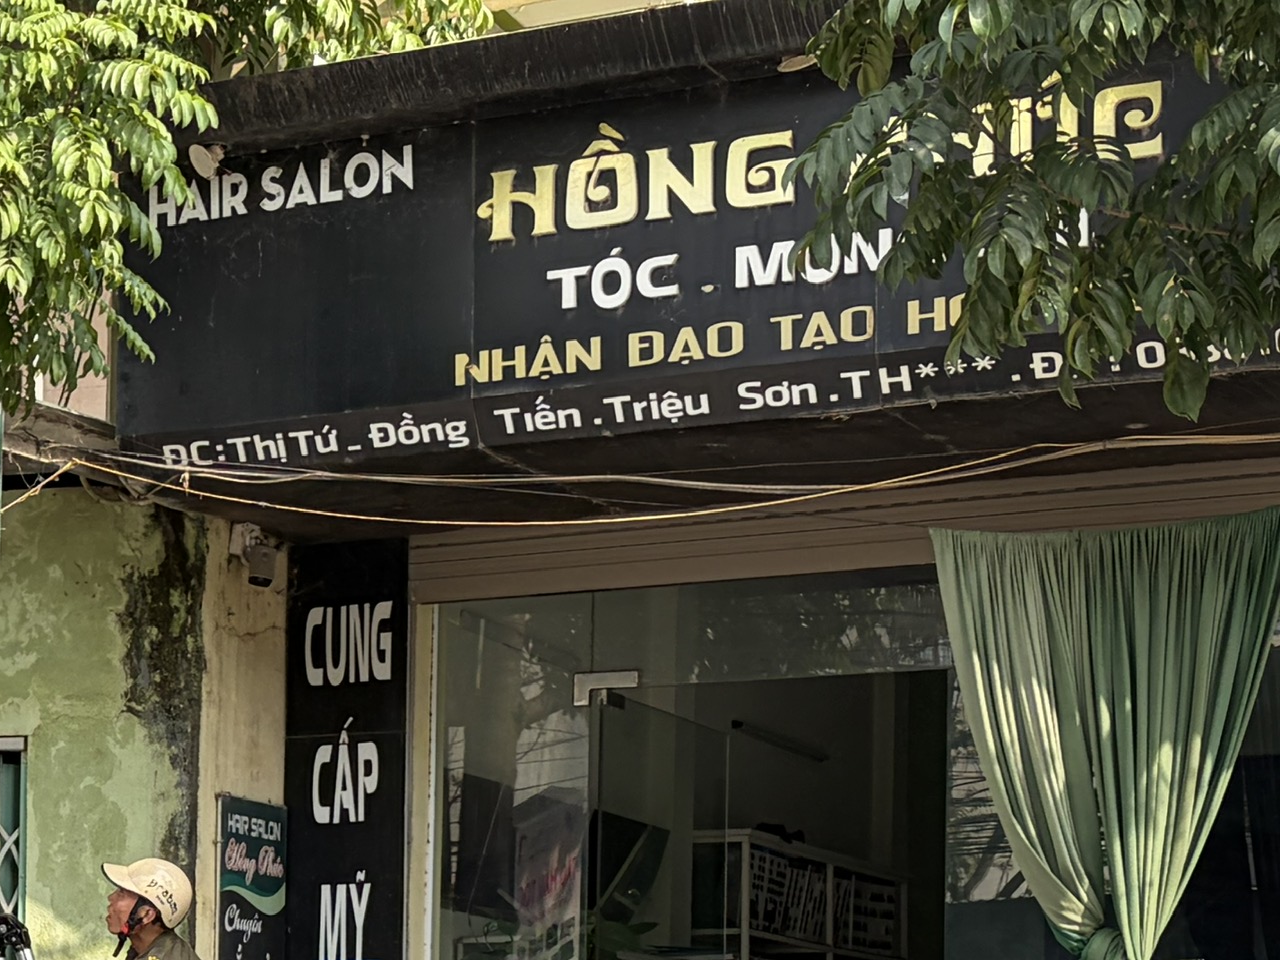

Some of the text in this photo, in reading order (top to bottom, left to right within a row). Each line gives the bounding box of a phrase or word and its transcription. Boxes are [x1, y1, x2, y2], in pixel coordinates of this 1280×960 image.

[149, 144, 413, 228] HAIR SALON
[476, 122, 797, 242] HỒNG
[546, 247, 680, 310] TÓC
[454, 335, 602, 386] NHẬN
[770, 305, 875, 351] TẠO
[288, 425, 338, 457] Tứ
[368, 412, 470, 448] Đồng
[493, 396, 582, 434] Tiến
[737, 381, 818, 410] Sơn
[305, 600, 393, 687] CUNG
[312, 716, 379, 824] CẤP
[250, 818, 281, 841] SALON
[224, 903, 263, 943] Chuyên
